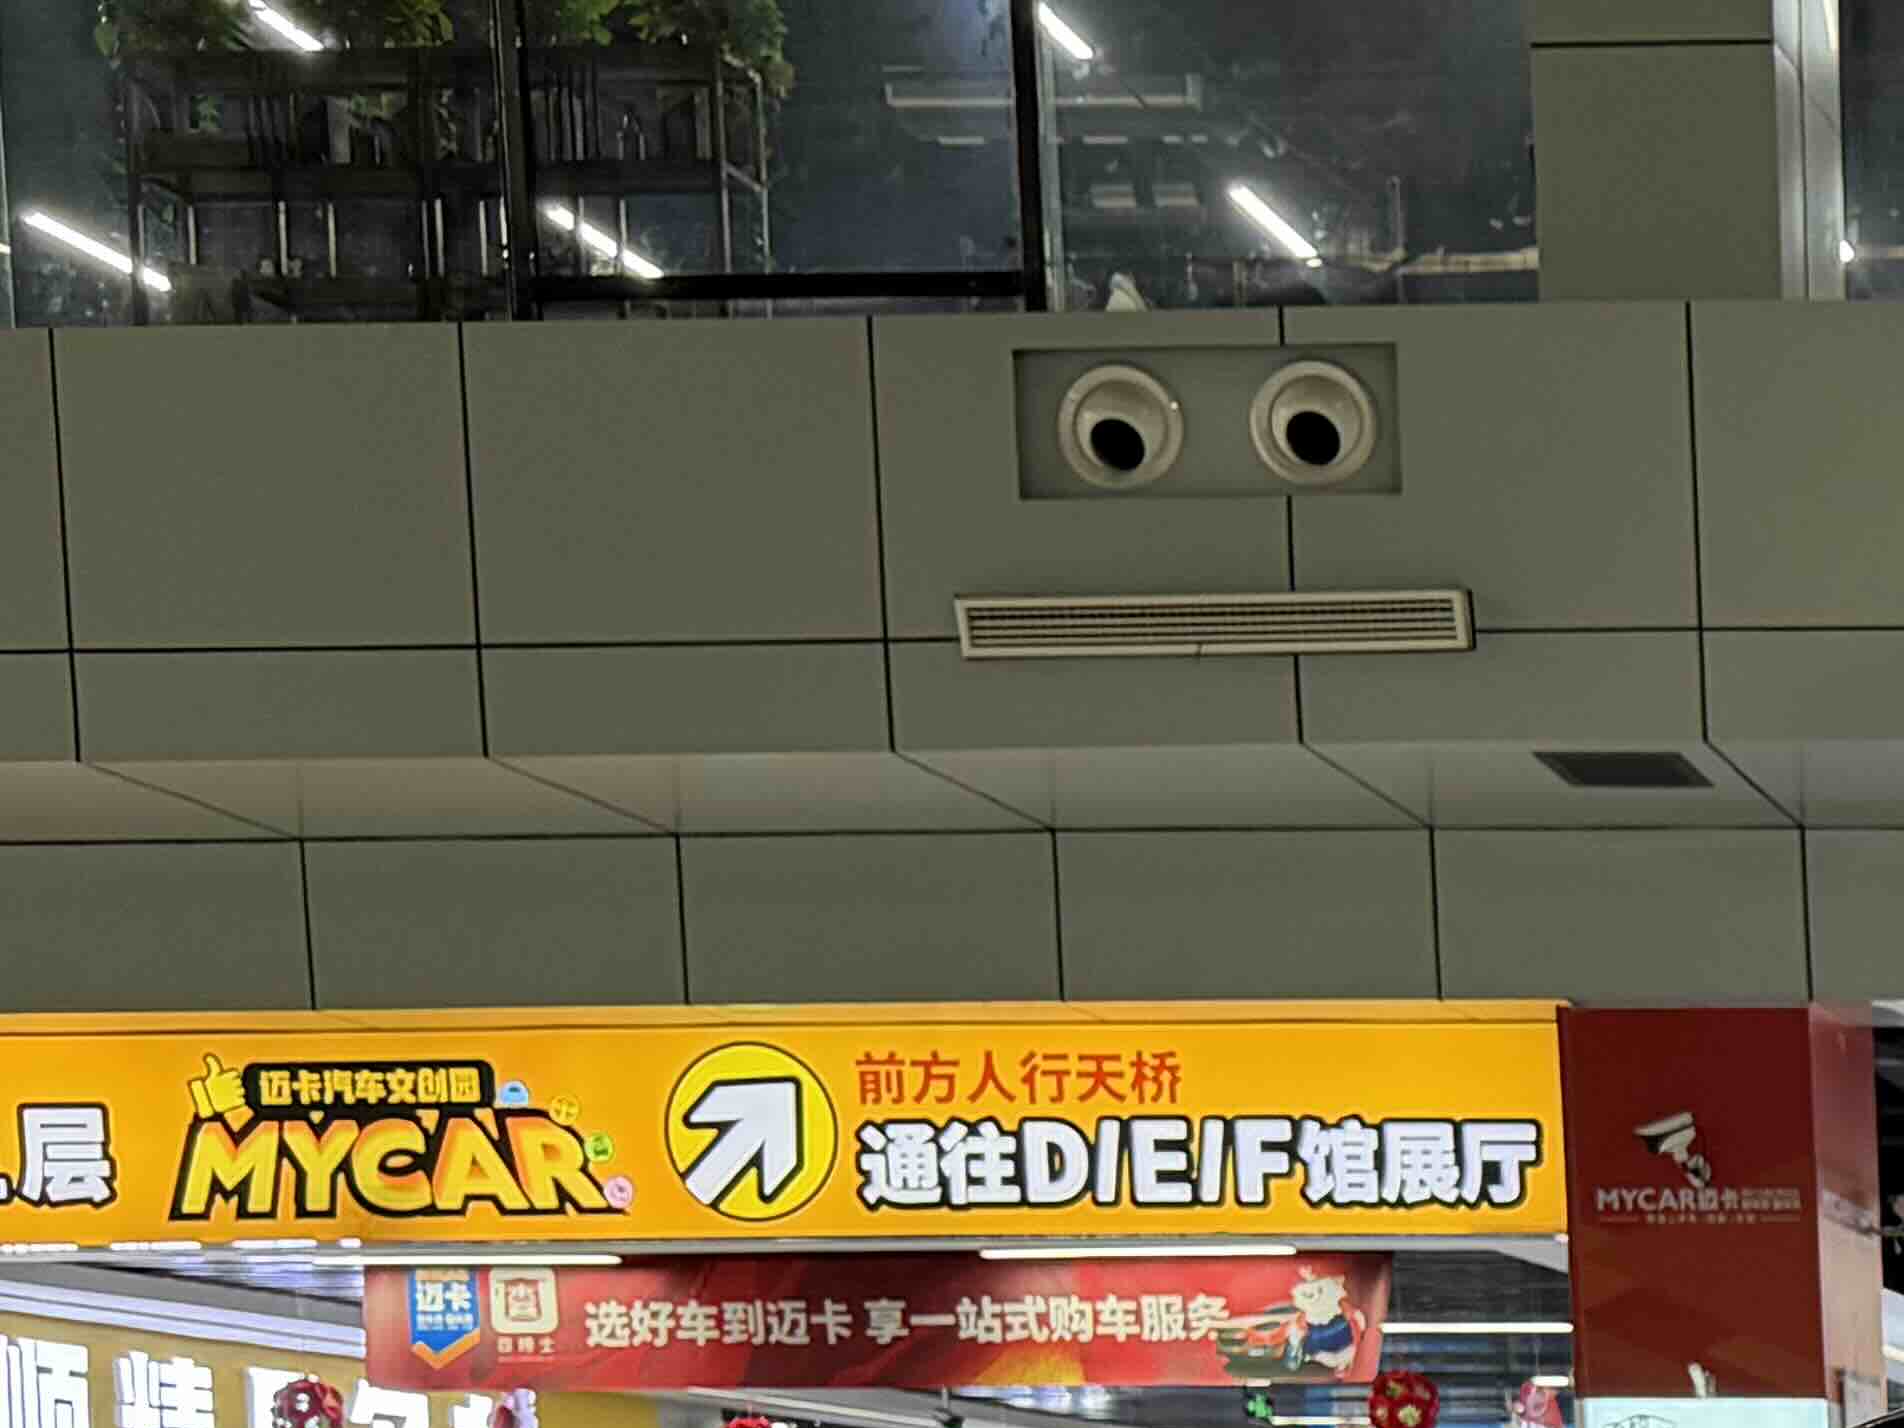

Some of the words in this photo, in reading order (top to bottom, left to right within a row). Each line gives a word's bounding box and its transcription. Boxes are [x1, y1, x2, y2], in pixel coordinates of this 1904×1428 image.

[259, 1068, 482, 1107] 迈卡汽车文创园
[855, 1051, 1181, 1106] 前方人行天桥
[0, 1105, 116, 1205] 层
[176, 1112, 618, 1218] MYCAR
[860, 1120, 1537, 1208] 通往D/E/F馆展厅
[1597, 1187, 1695, 1212] MYCAR
[585, 1299, 853, 1349] 选好车到迈卡
[864, 1293, 1237, 1344] 享一站式购车服务
